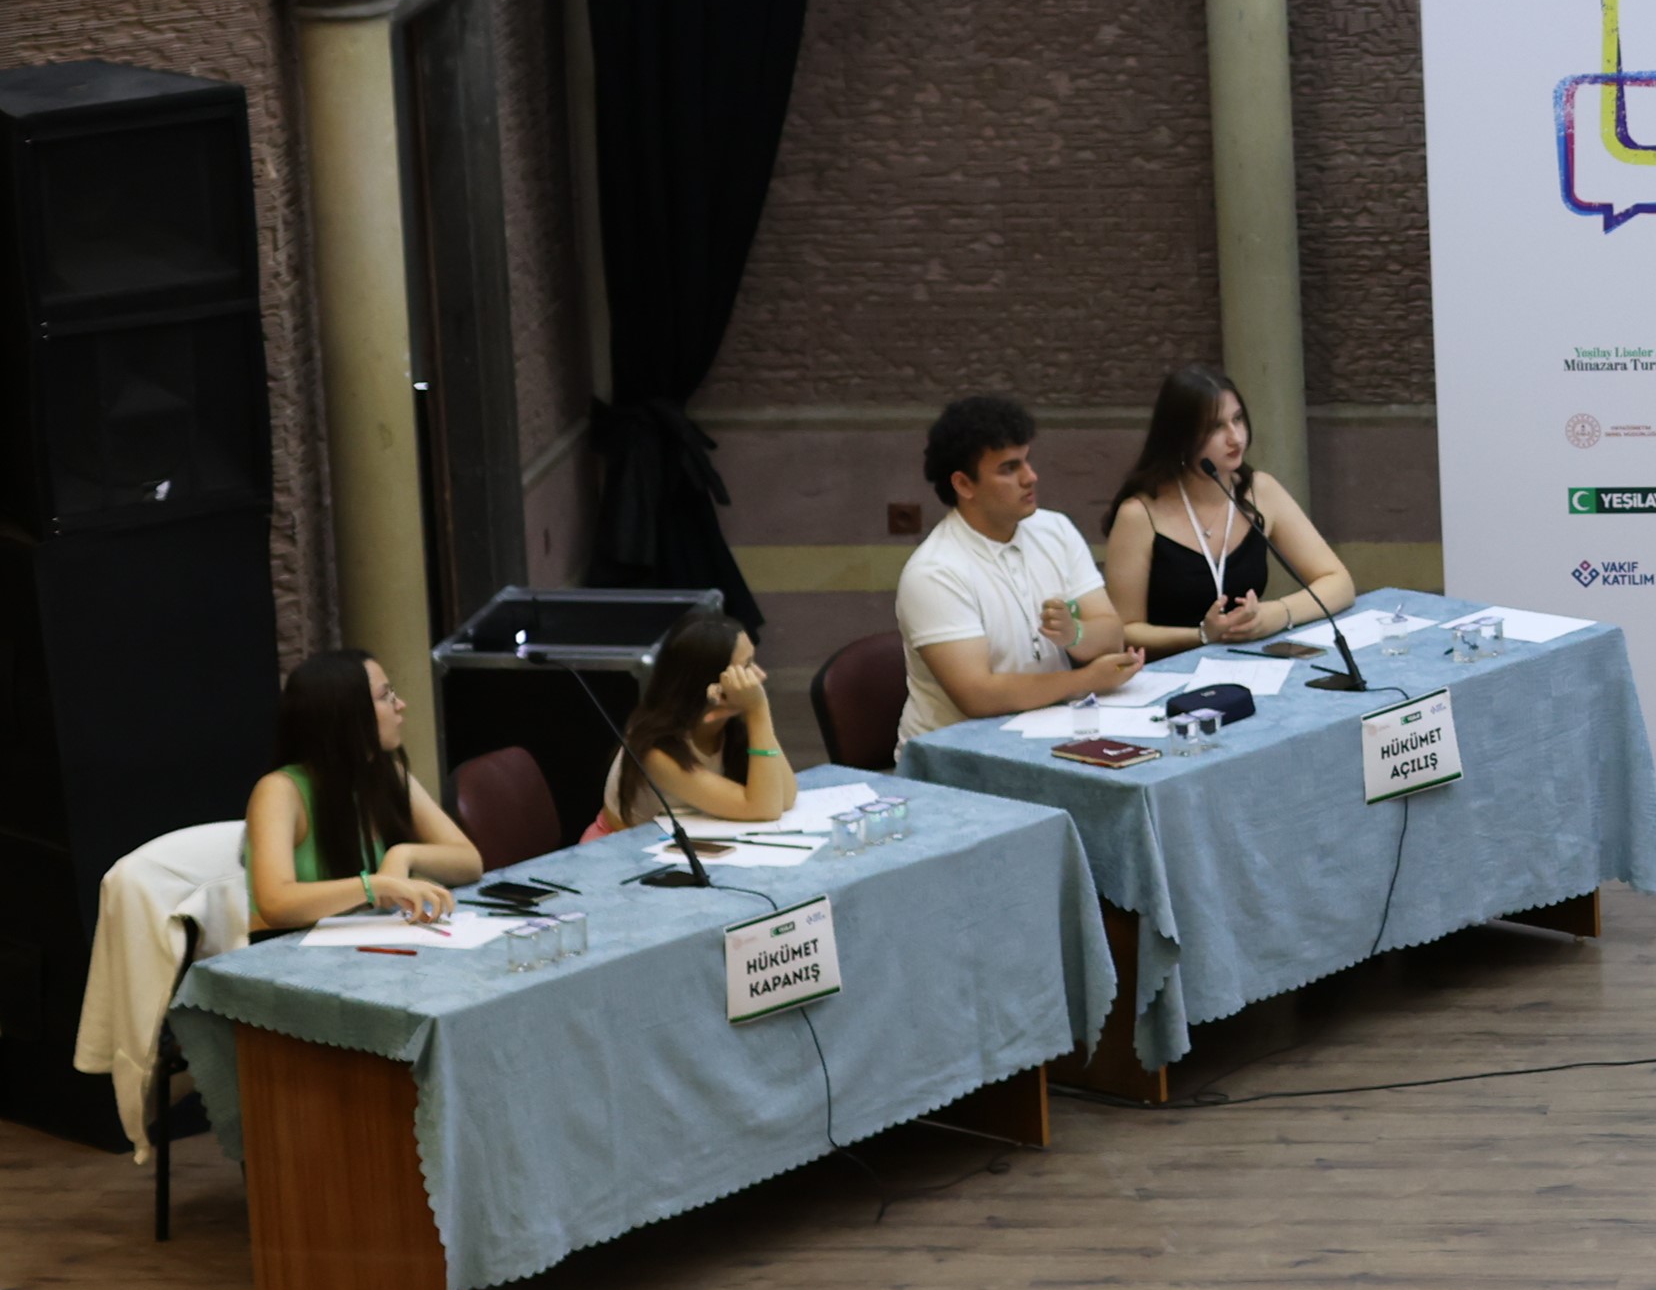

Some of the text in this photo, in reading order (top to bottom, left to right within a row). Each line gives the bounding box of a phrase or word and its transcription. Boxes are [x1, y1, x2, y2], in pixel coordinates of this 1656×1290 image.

[1602, 562, 1638, 573] VAKIF
[1602, 574, 1655, 585] KATILIM
[1381, 727, 1442, 760] HÜKÜMET
[1390, 752, 1439, 779] AÇILIŞ
[746, 938, 819, 975] HÜKÜMET
[749, 963, 821, 997] KAPANIŞ
